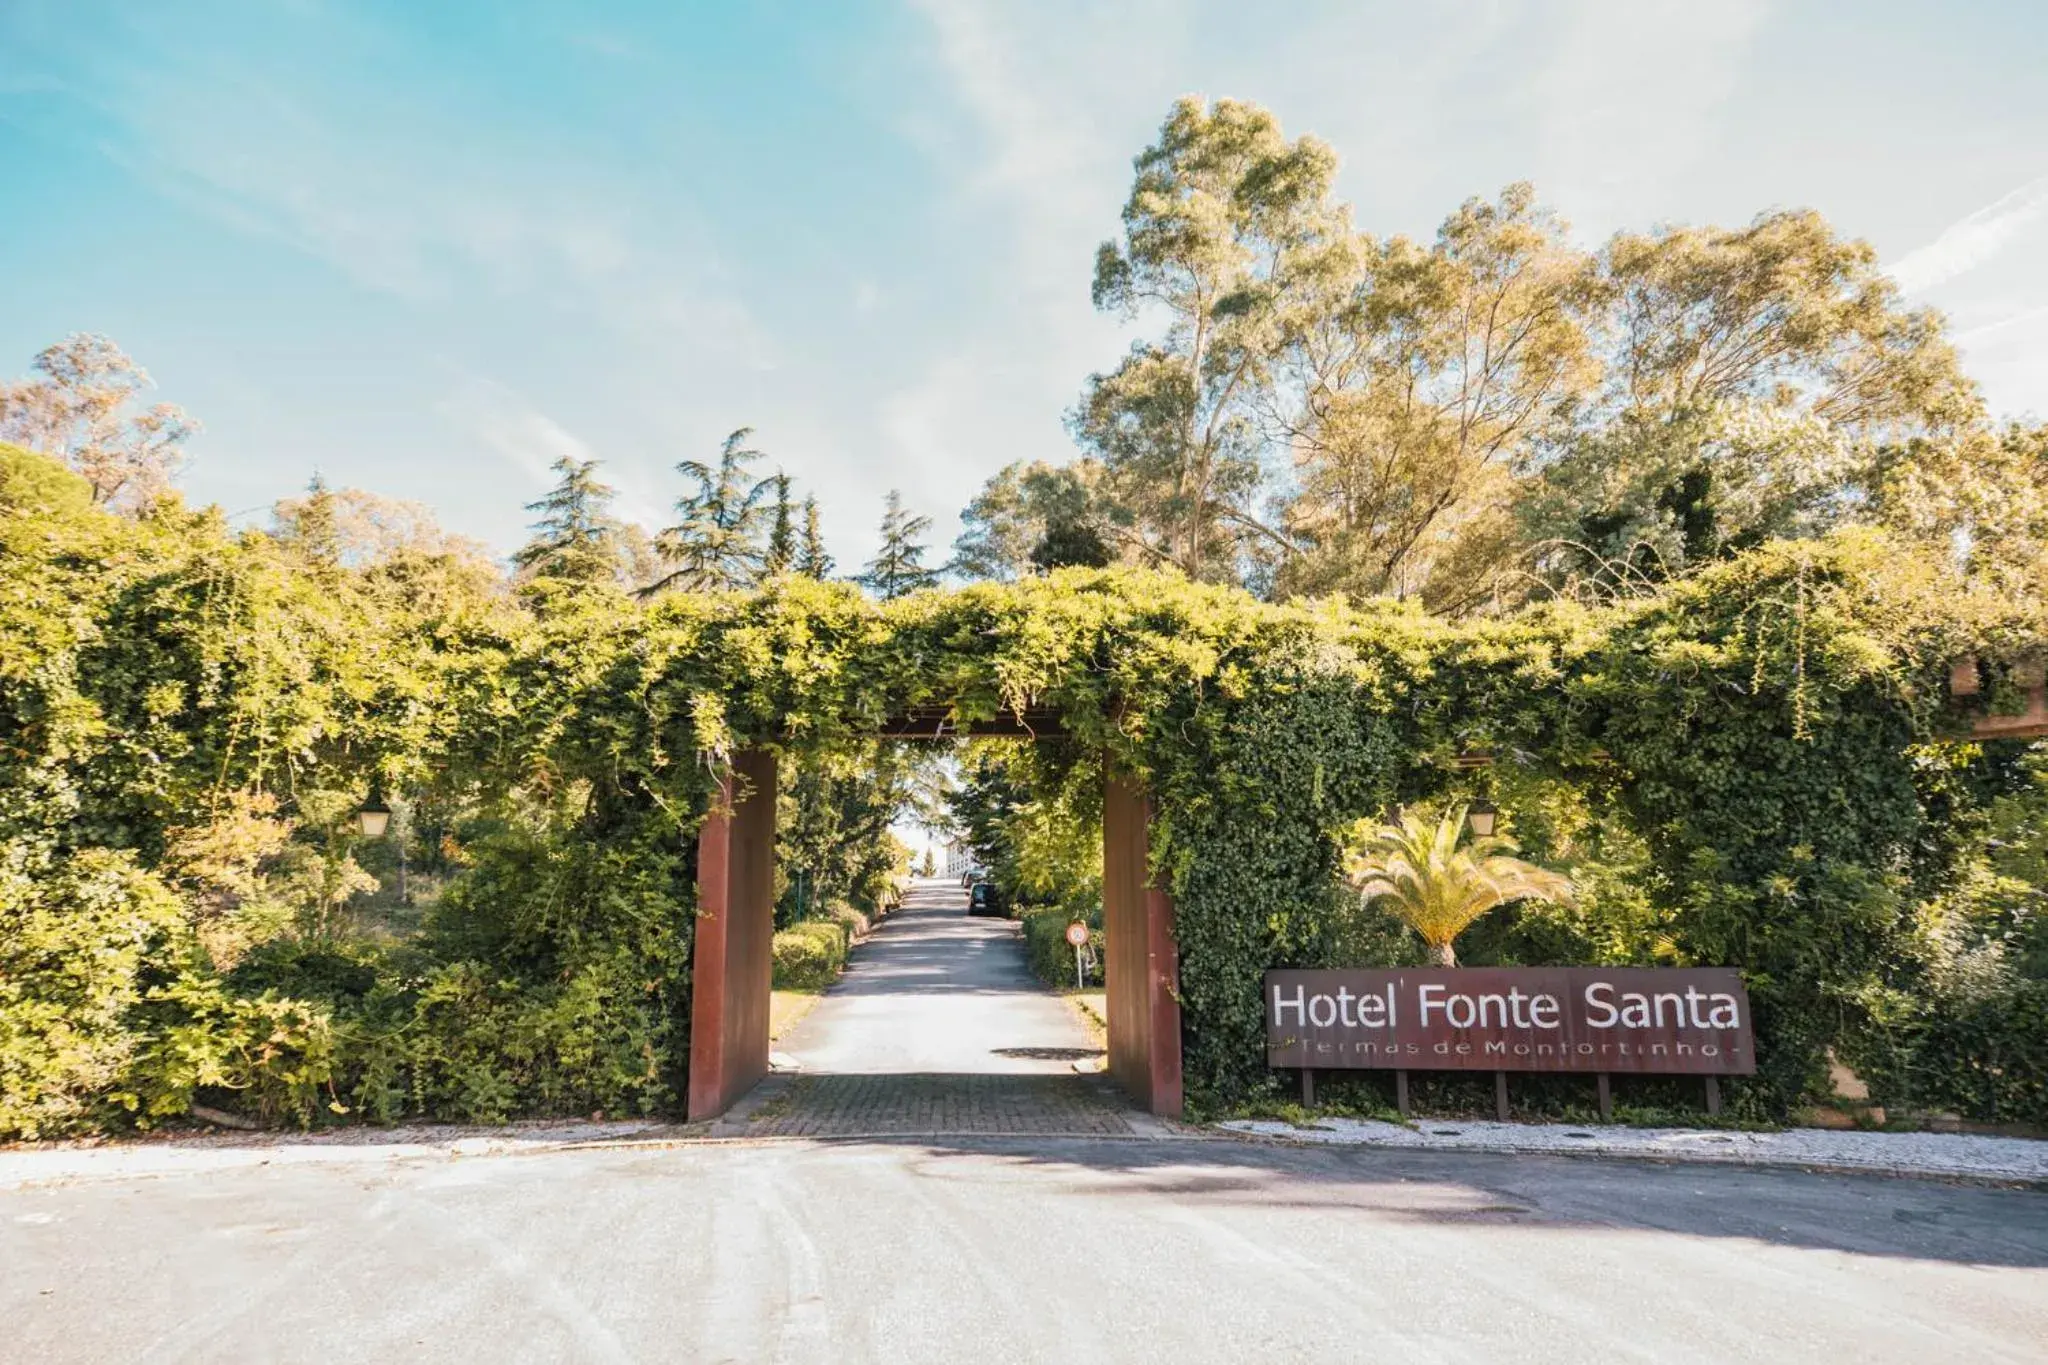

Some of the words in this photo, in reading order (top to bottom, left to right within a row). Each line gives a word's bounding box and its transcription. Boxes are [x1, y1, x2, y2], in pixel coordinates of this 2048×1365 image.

[1273, 983, 1396, 1028] Hotel
[1419, 984, 1560, 1029] Fonte
[1585, 982, 1740, 1030] Santa
[1301, 1038, 1420, 1055] Termas
[1434, 1039, 1472, 1055] de
[1485, 1040, 1719, 1057] Monfortinho
